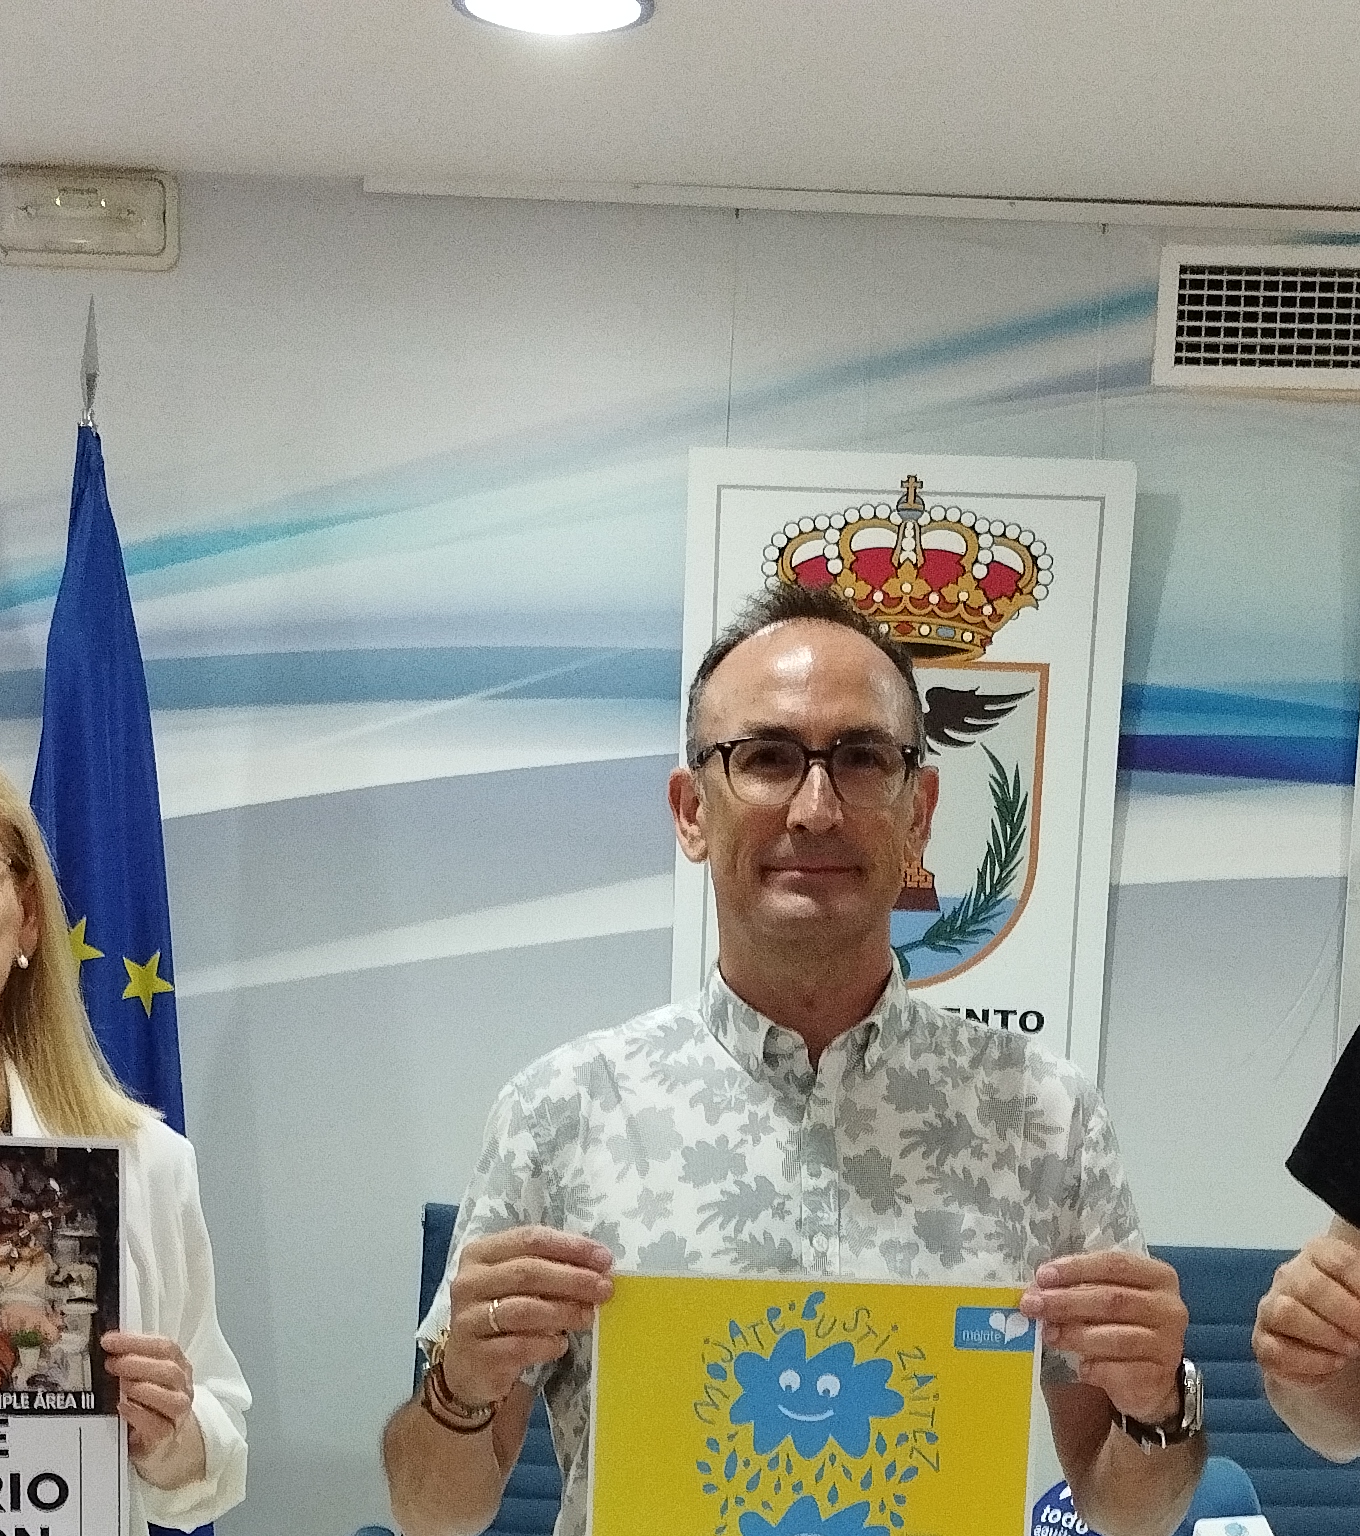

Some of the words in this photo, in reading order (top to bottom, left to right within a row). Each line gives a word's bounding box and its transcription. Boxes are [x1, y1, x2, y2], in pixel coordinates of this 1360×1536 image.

[939, 1007, 1045, 1035] NTO
[33, 1388, 77, 1410] ÁREA
[81, 1392, 95, 1410] III
